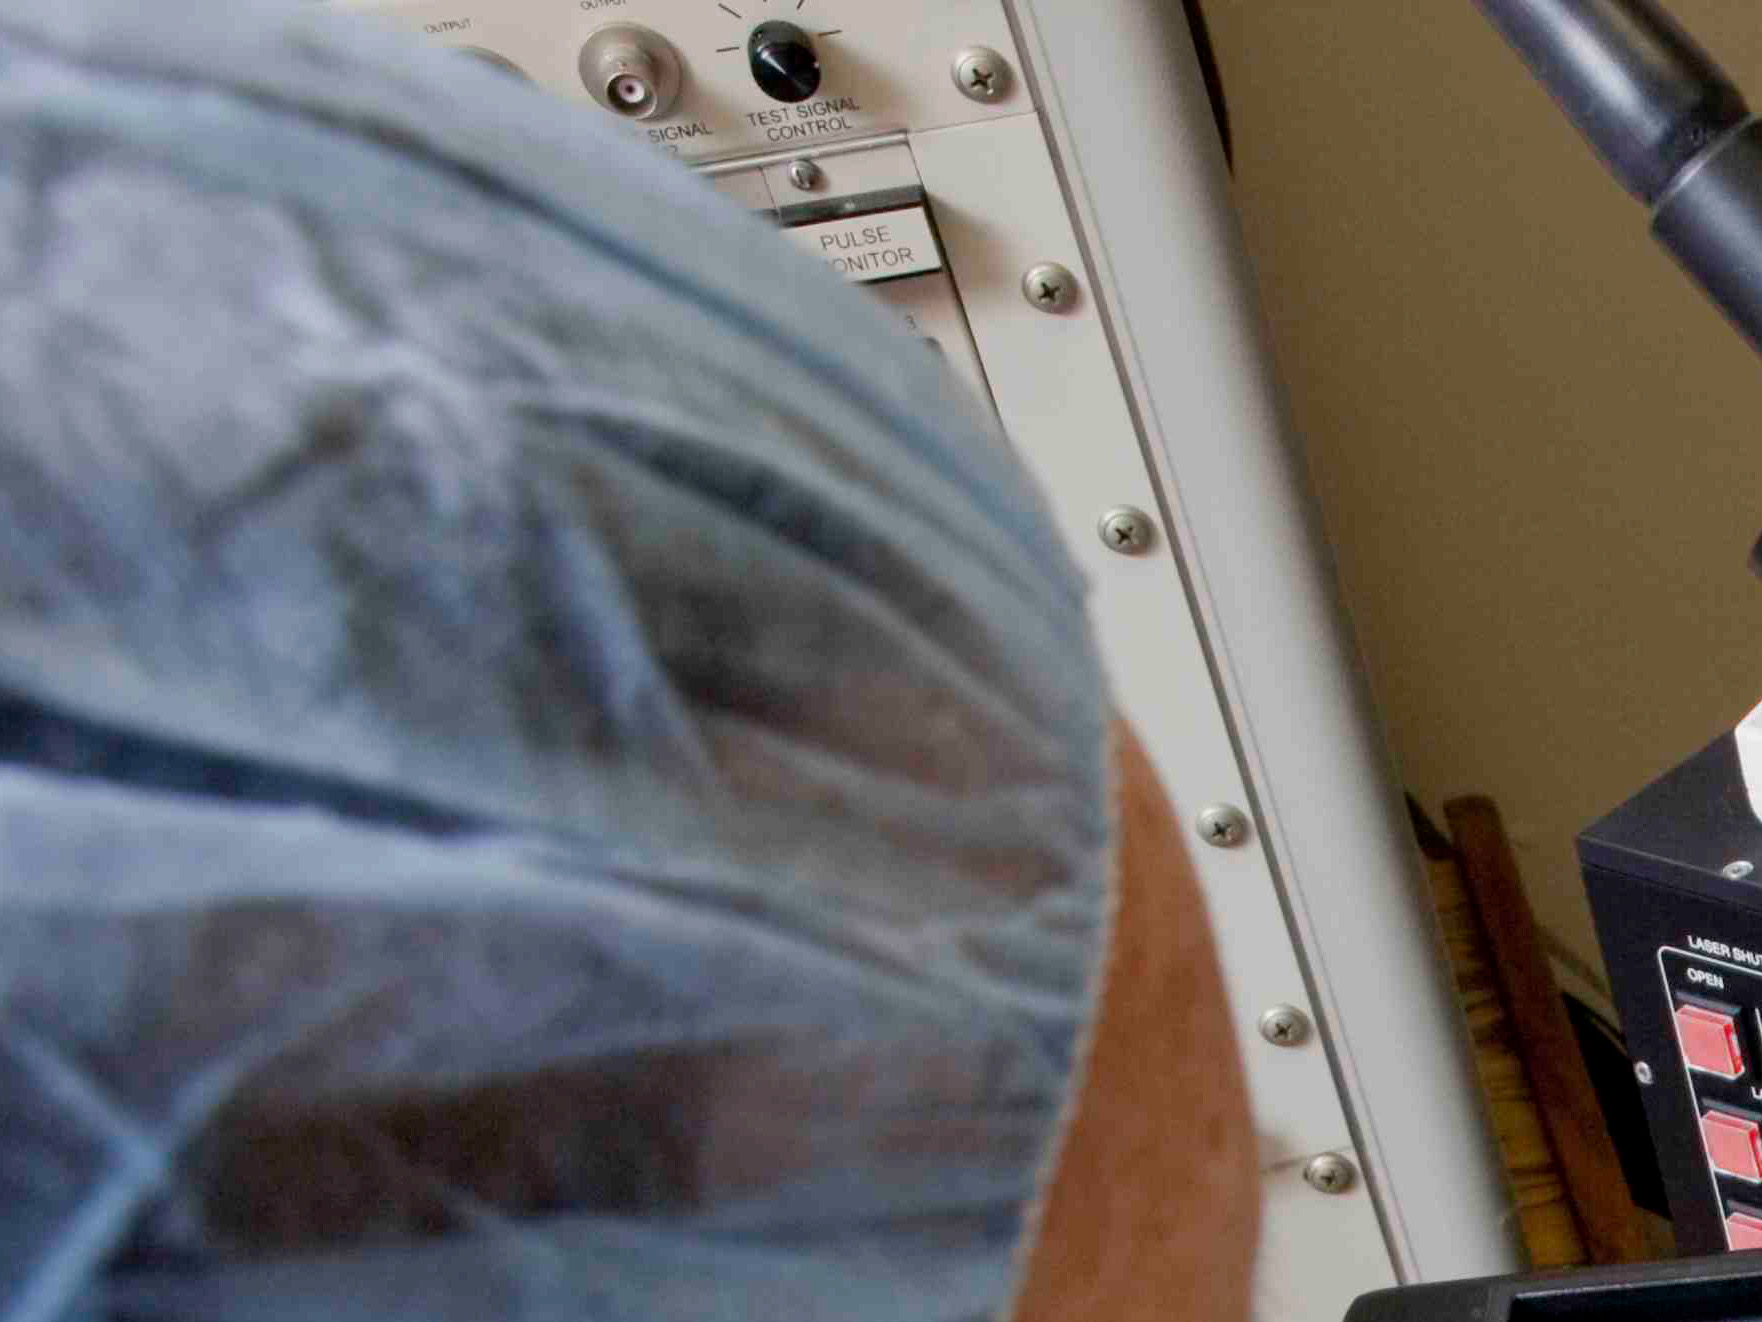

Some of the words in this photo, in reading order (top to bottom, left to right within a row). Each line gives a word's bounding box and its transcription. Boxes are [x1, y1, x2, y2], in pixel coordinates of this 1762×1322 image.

[747, 107, 790, 127] TEST
[797, 96, 860, 119] SIGNAL
[649, 121, 714, 144] SIGNAL
[766, 116, 853, 142] CONTROL
[819, 224, 892, 250] PULSE
[833, 247, 915, 273] ONITOR
[1687, 935, 1731, 959] LASER
[1686, 968, 1725, 989] OPEN
